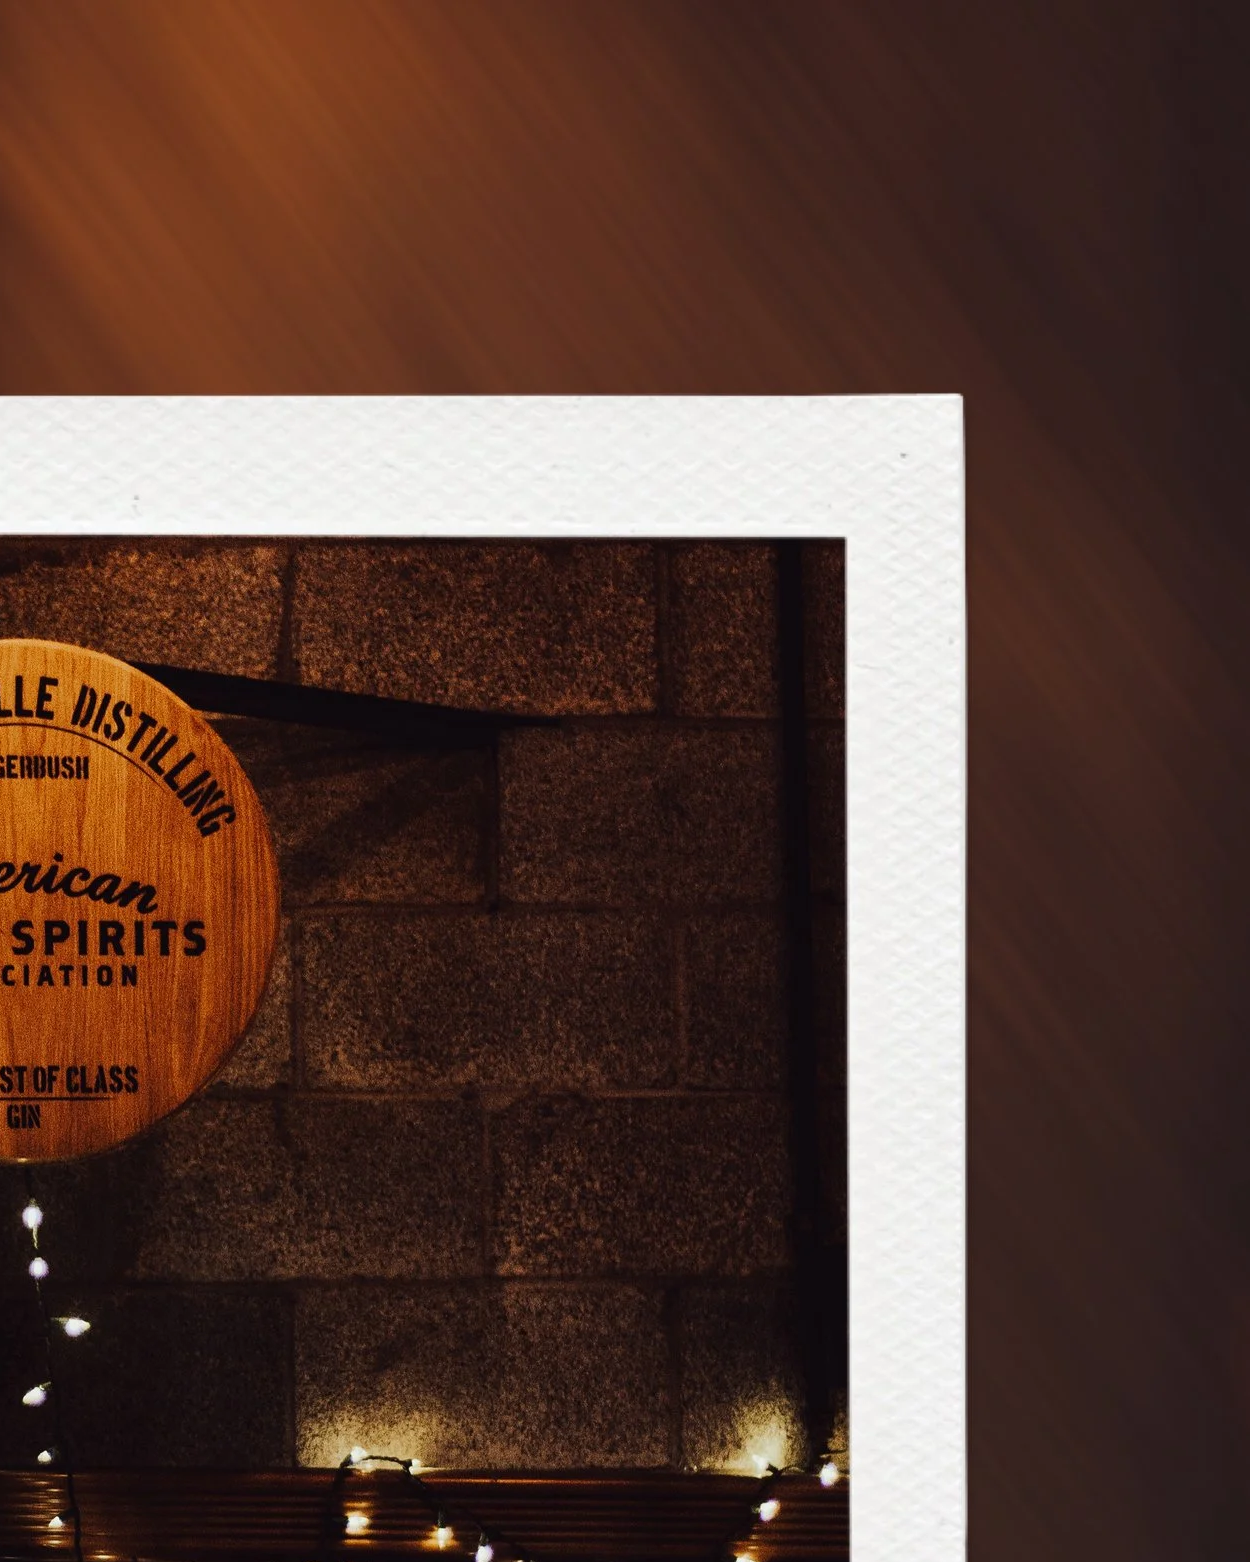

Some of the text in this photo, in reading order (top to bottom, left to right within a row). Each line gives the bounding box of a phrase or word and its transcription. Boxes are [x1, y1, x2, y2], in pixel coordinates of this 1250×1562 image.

[71, 684, 237, 838] DISTILLING
[11, 919, 207, 957] SPIRITS
[33, 1067, 59, 1094] OF
[66, 1067, 139, 1094] CLASS
[7, 1104, 41, 1129] GIN
